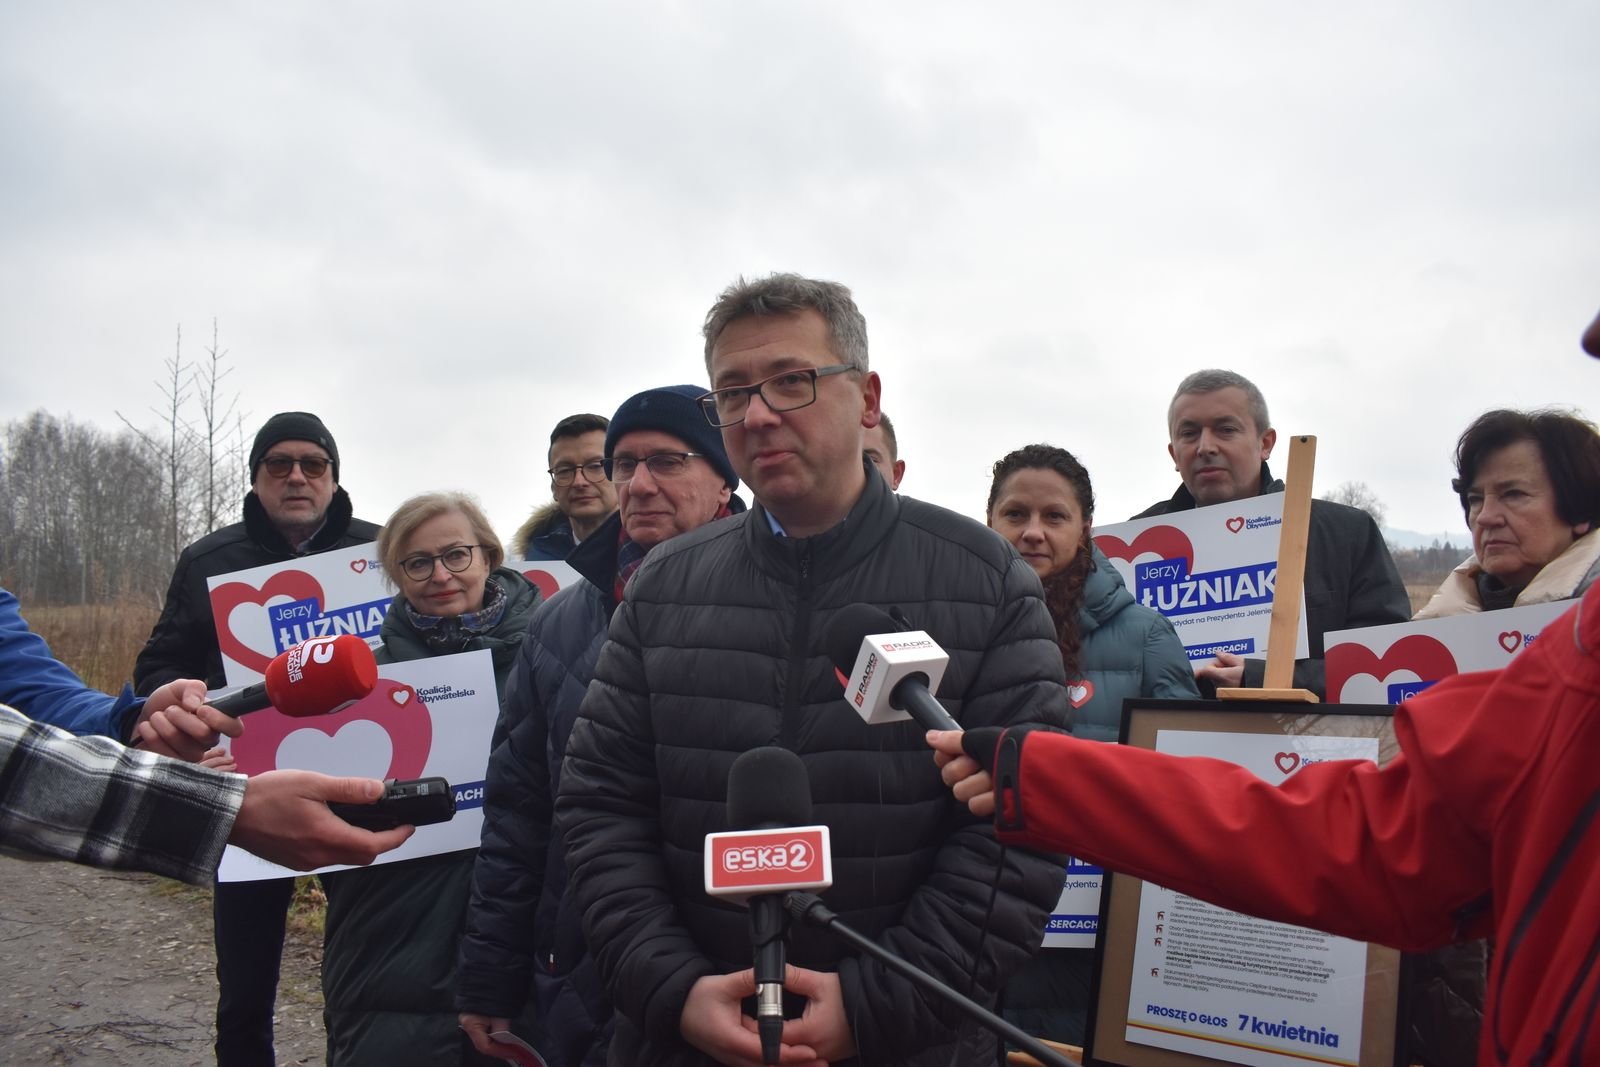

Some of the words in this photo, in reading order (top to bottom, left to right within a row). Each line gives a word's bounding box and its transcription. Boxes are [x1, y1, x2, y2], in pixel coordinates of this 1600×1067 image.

[1142, 564, 1180, 580] Jerzy
[1141, 568, 1277, 612] ŁUŻNIAK
[276, 604, 312, 621] Jerzy
[1207, 612, 1246, 622] Prezydenta
[1247, 608, 1272, 617] Jelenie
[280, 603, 391, 649] ŁUŻNIA
[892, 640, 932, 649] RADIO
[287, 650, 296, 683] RADIO
[859, 652, 876, 693] RADIO
[416, 684, 452, 696] Koalicja
[417, 688, 475, 704] Obywatelska
[455, 787, 484, 802] ACH
[1050, 919, 1098, 929] SERCACH
[1146, 1004, 1187, 1023] PROSZĘ
[1188, 1012, 1197, 1022] O
[1199, 1014, 1228, 1027] GŁOS
[1238, 1014, 1249, 1031] 7
[1251, 1016, 1339, 1048] kwietnia
